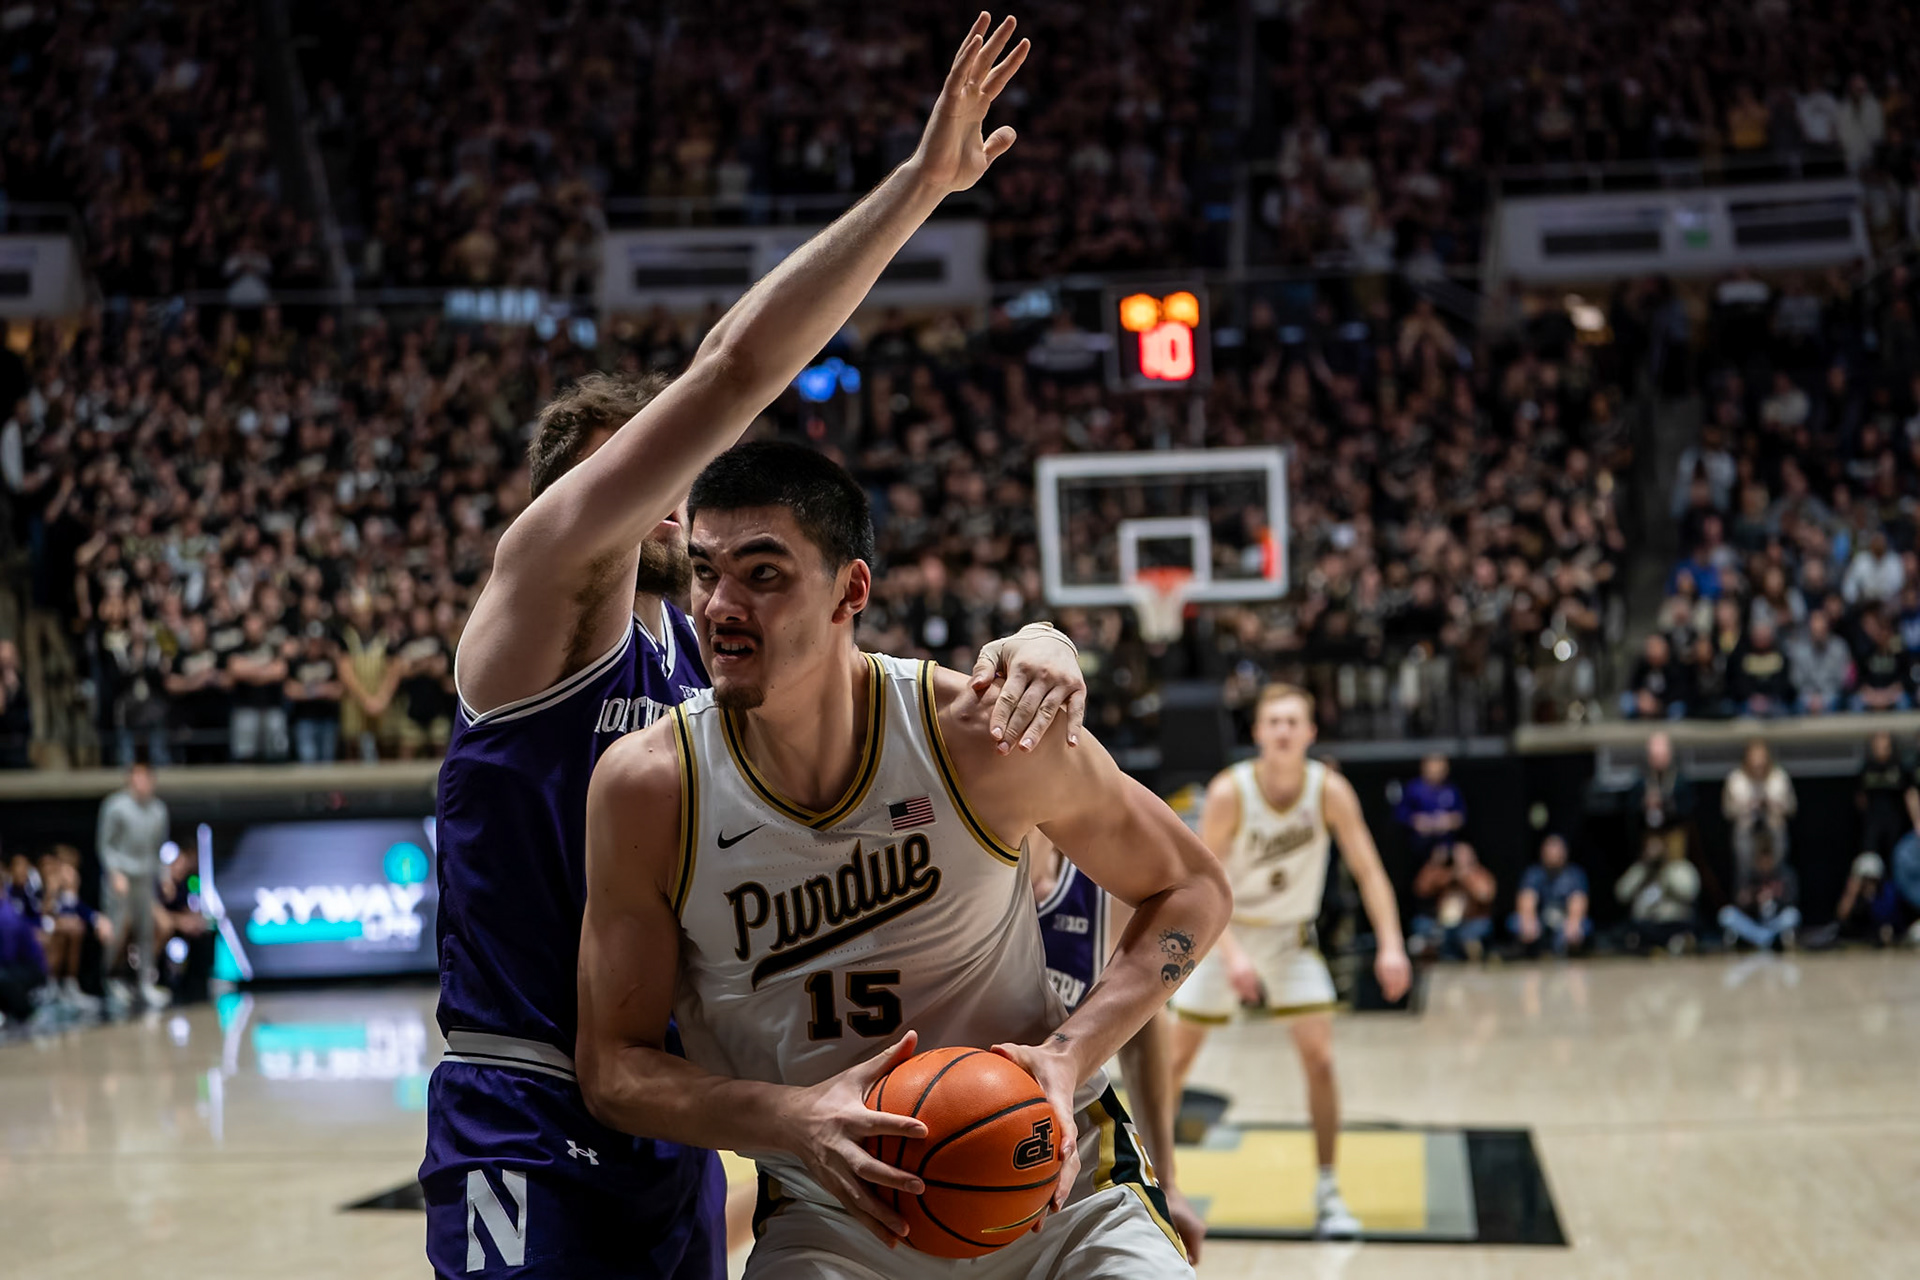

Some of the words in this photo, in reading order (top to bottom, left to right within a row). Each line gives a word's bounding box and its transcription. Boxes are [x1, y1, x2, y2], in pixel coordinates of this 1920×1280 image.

[1138, 321, 1196, 382] 10
[723, 832, 942, 978] Purdue
[804, 968, 904, 1041] 15
[1012, 1117, 1054, 1170] P
[465, 1168, 528, 1273] N
